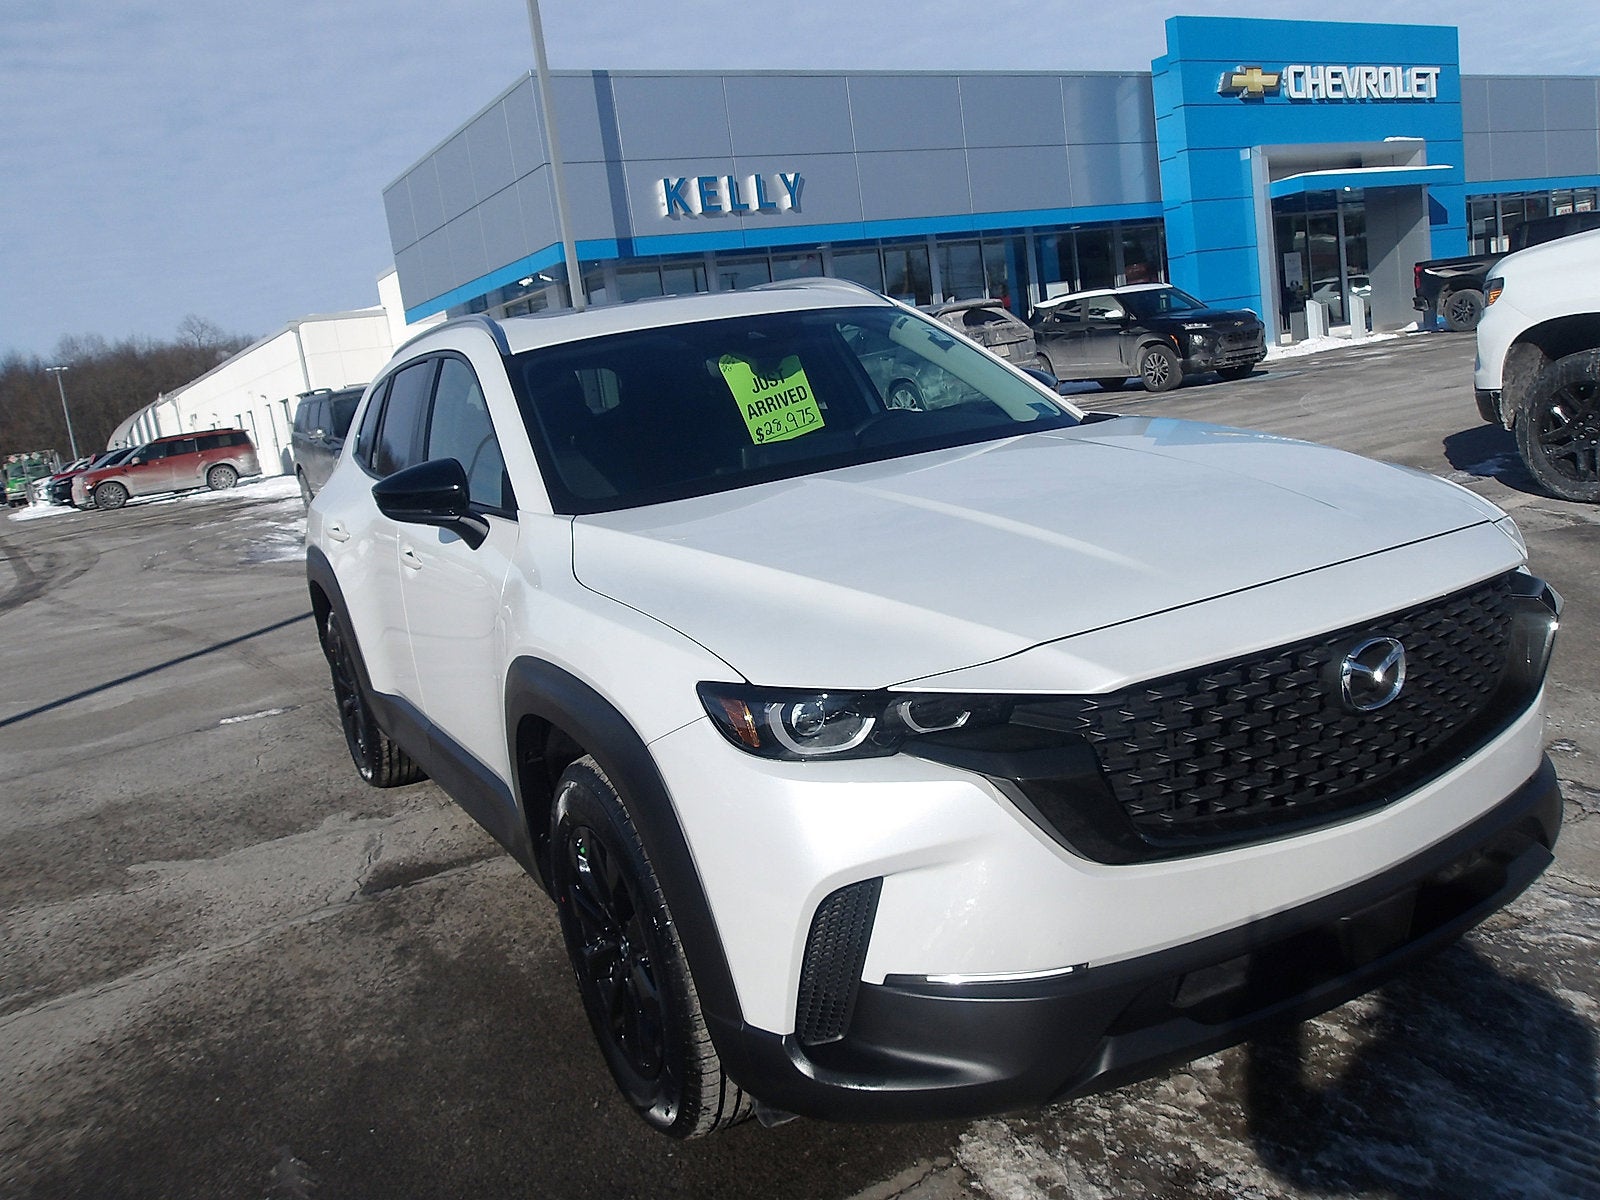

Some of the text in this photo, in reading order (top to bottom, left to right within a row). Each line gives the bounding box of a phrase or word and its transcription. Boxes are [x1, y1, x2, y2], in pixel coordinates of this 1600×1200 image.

[1284, 65, 1440, 99] CHEVROLET
[661, 172, 801, 216] KELLY
[746, 385, 808, 420] ARRIVED
[755, 406, 816, 443] $28,975
